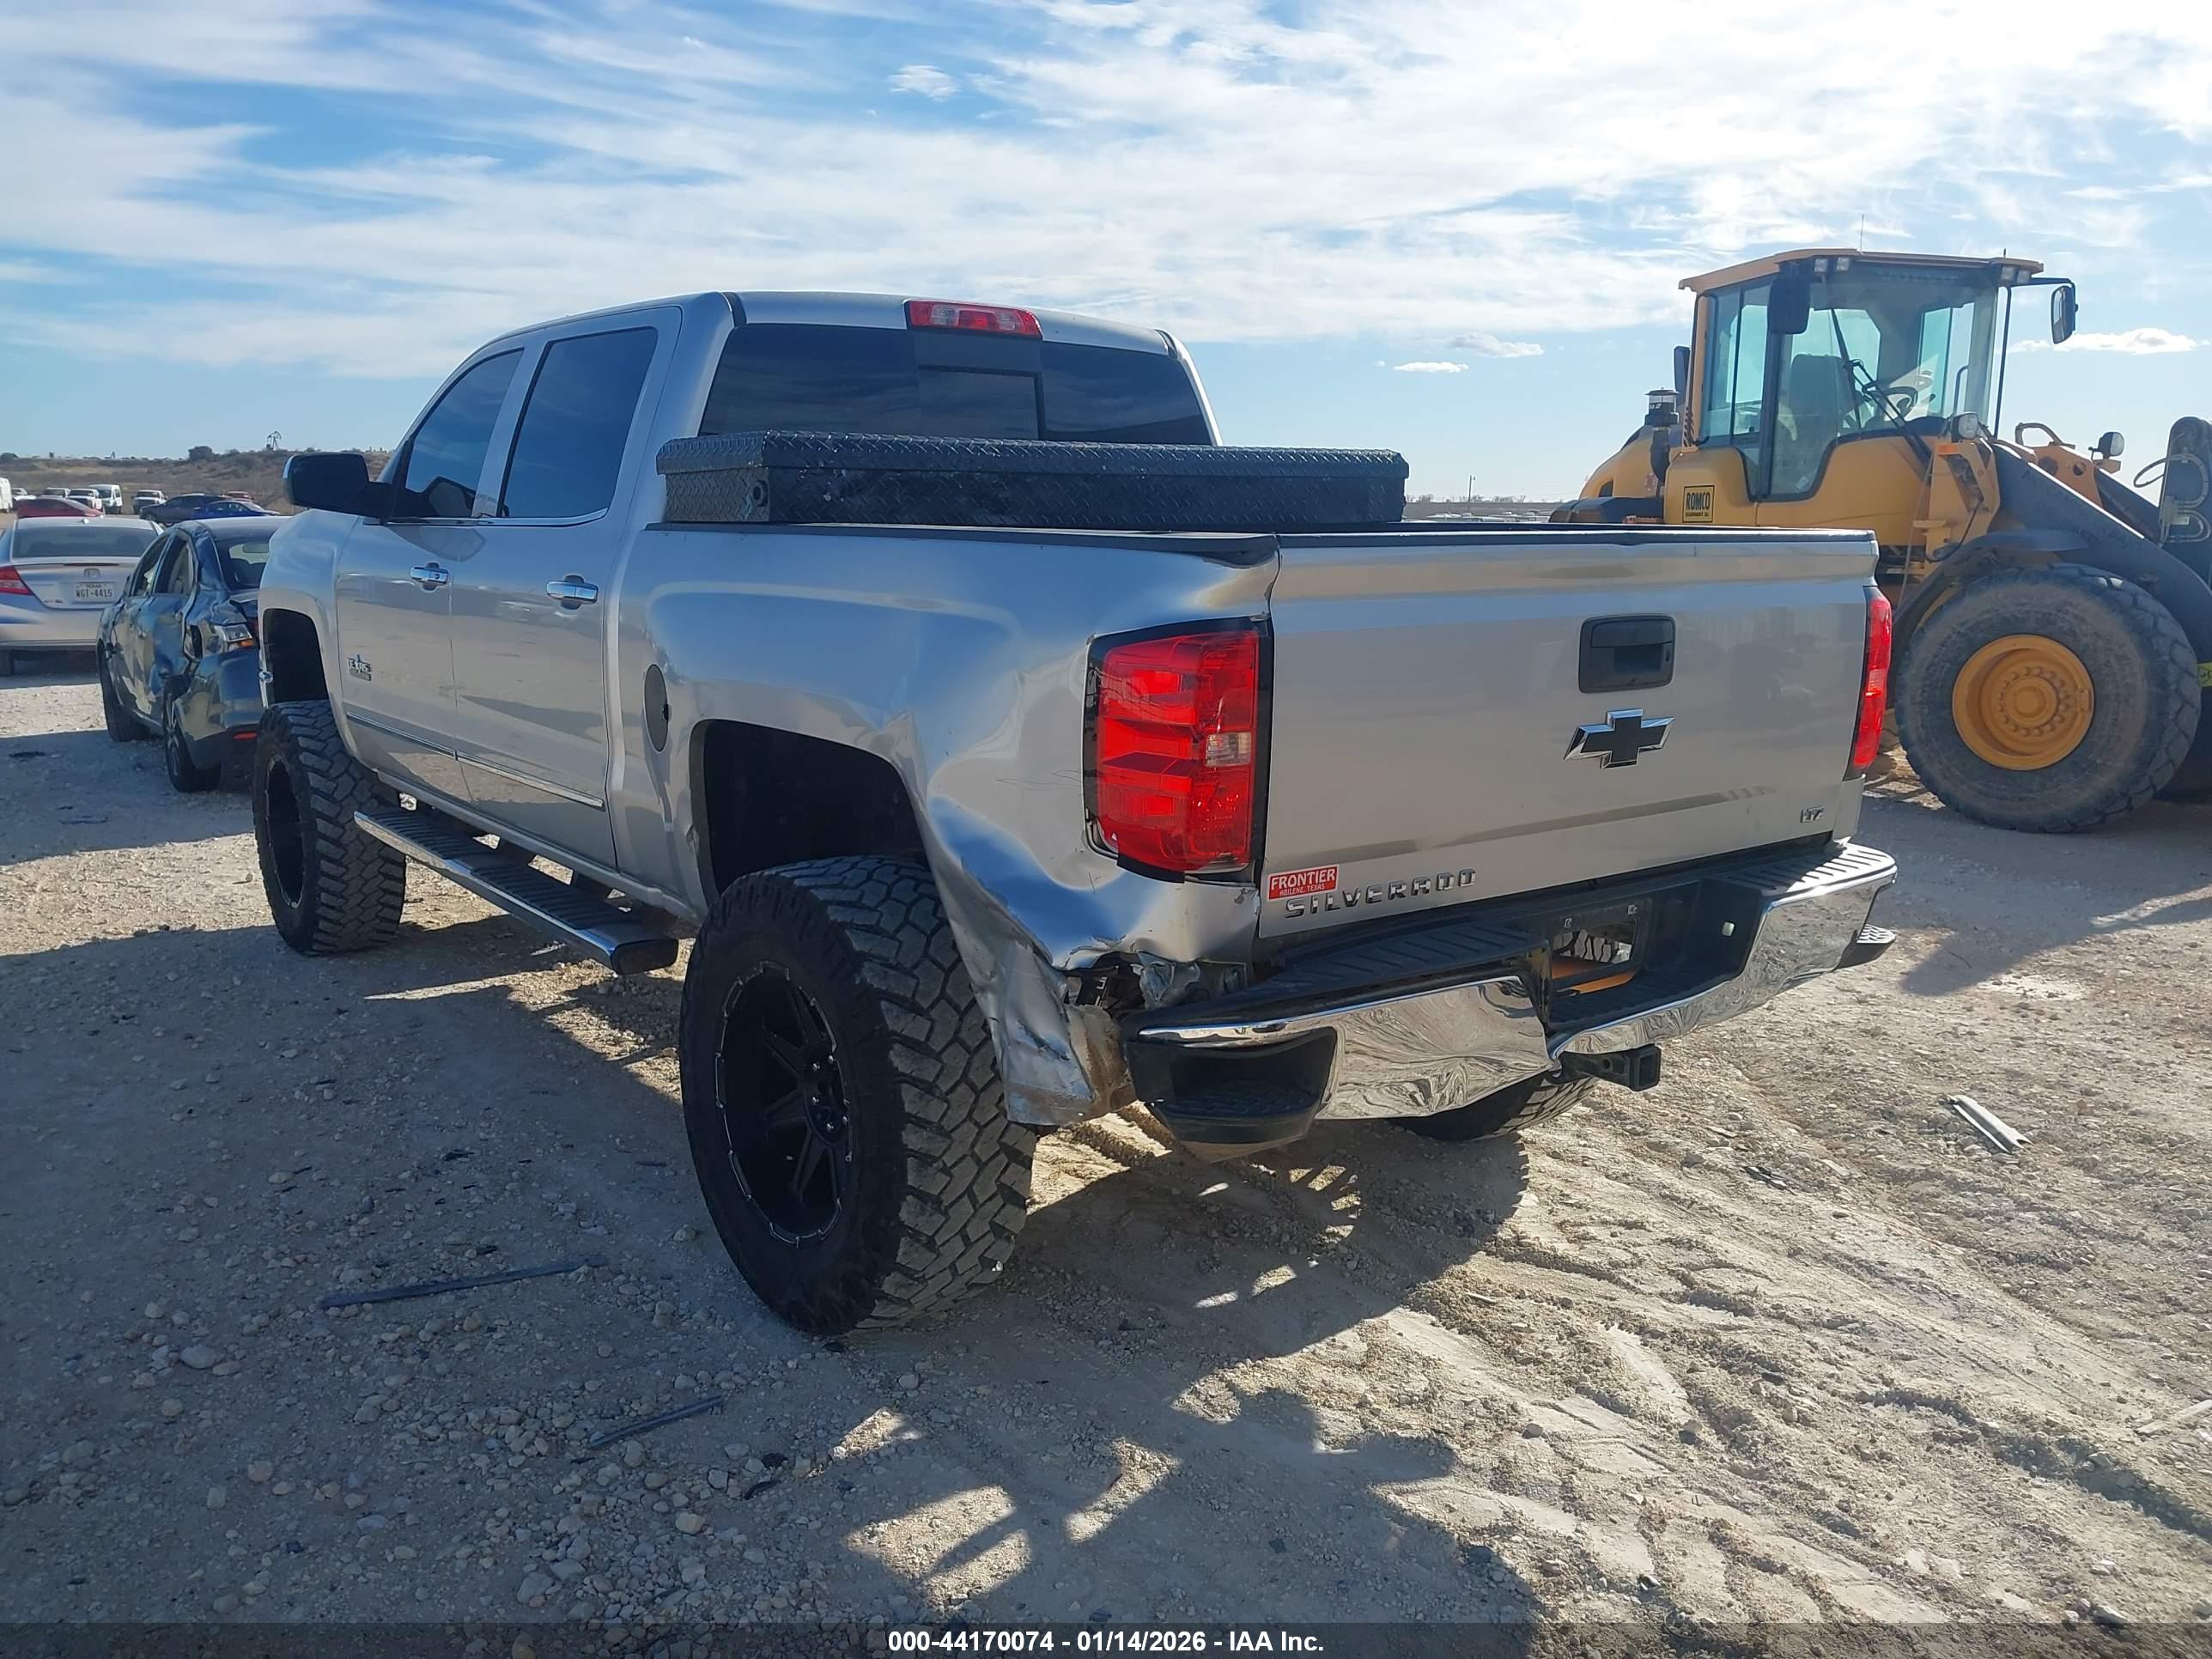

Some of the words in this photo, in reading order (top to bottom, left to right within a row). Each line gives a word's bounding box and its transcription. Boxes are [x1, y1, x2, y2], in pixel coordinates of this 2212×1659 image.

[1686, 491, 1711, 511] ROMCO
[1271, 868, 1336, 890] FRONTIER
[1307, 883, 1325, 892] TEXAS
[1285, 868, 1477, 918] SILVERADO
